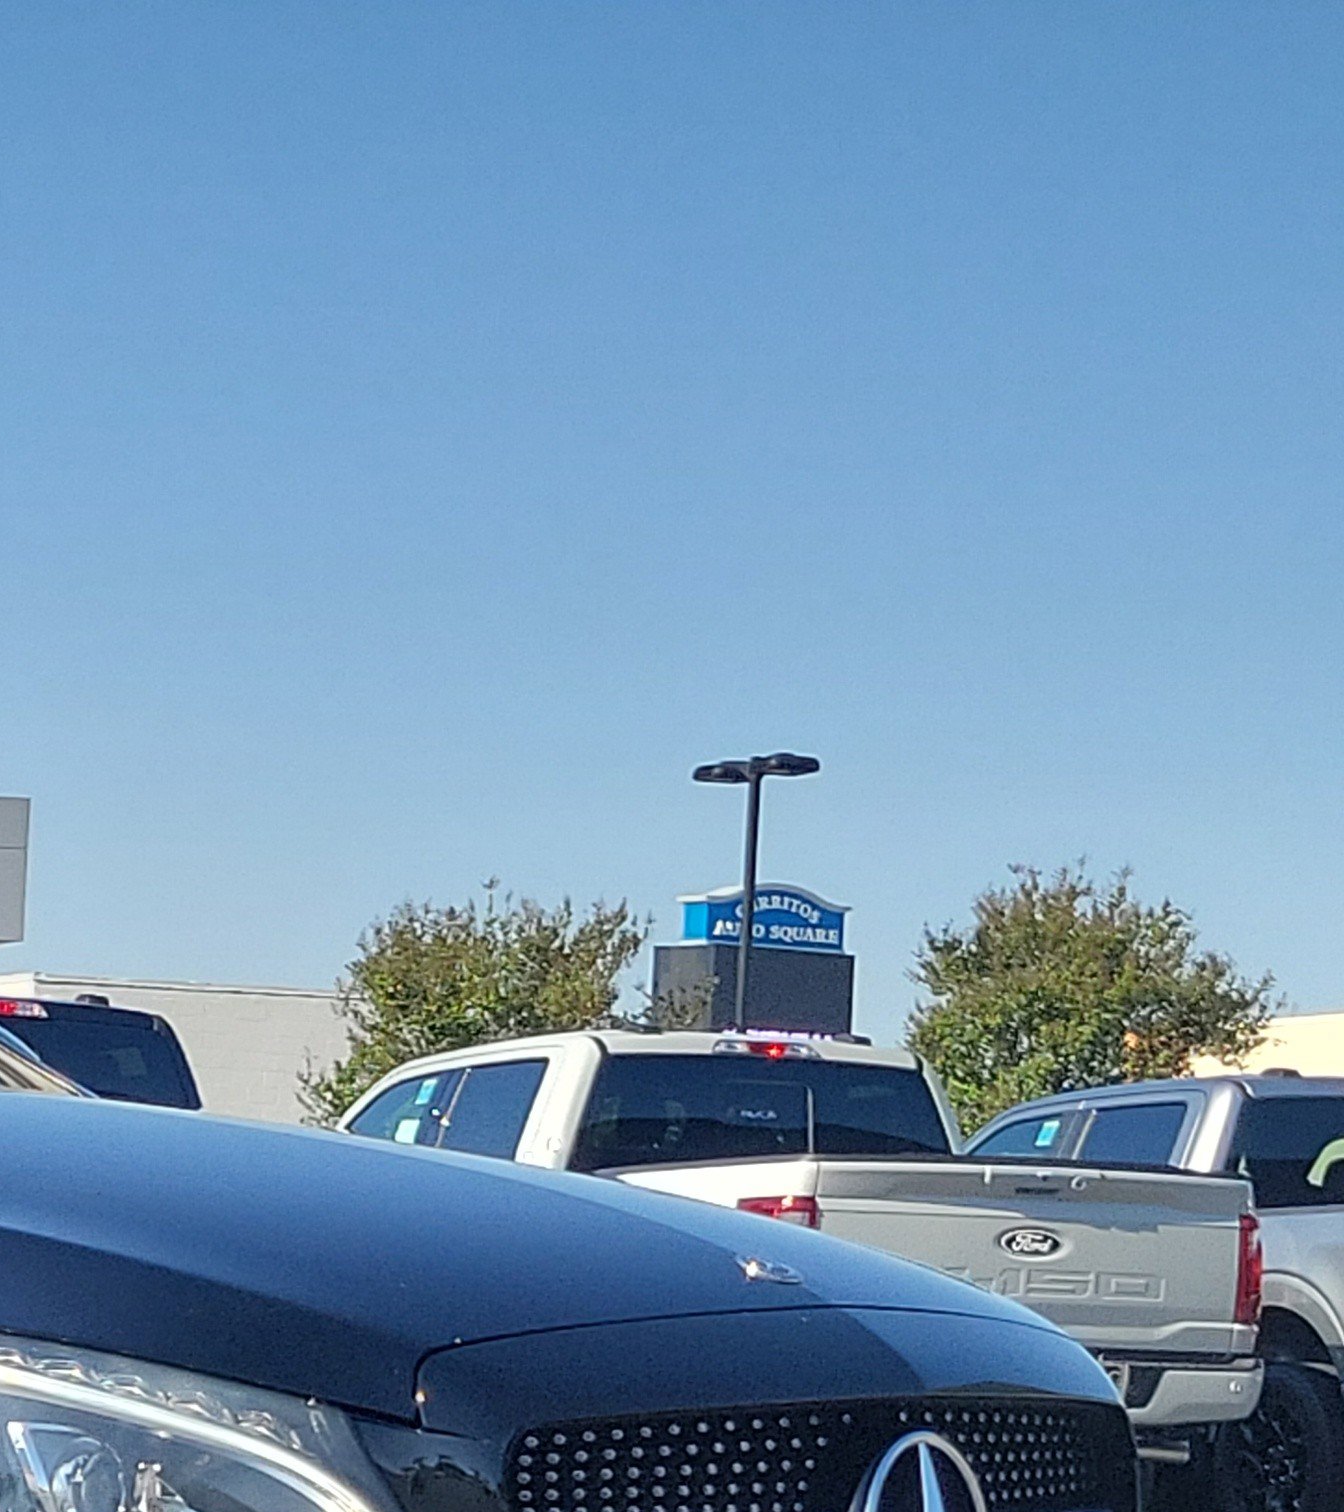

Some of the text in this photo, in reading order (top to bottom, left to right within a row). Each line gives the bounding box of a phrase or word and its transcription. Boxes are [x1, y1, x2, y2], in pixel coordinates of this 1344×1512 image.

[735, 895, 821, 924] CRRITOS
[712, 919, 840, 945] AUO SQUARE
[1012, 1233, 1054, 1253] Ford
